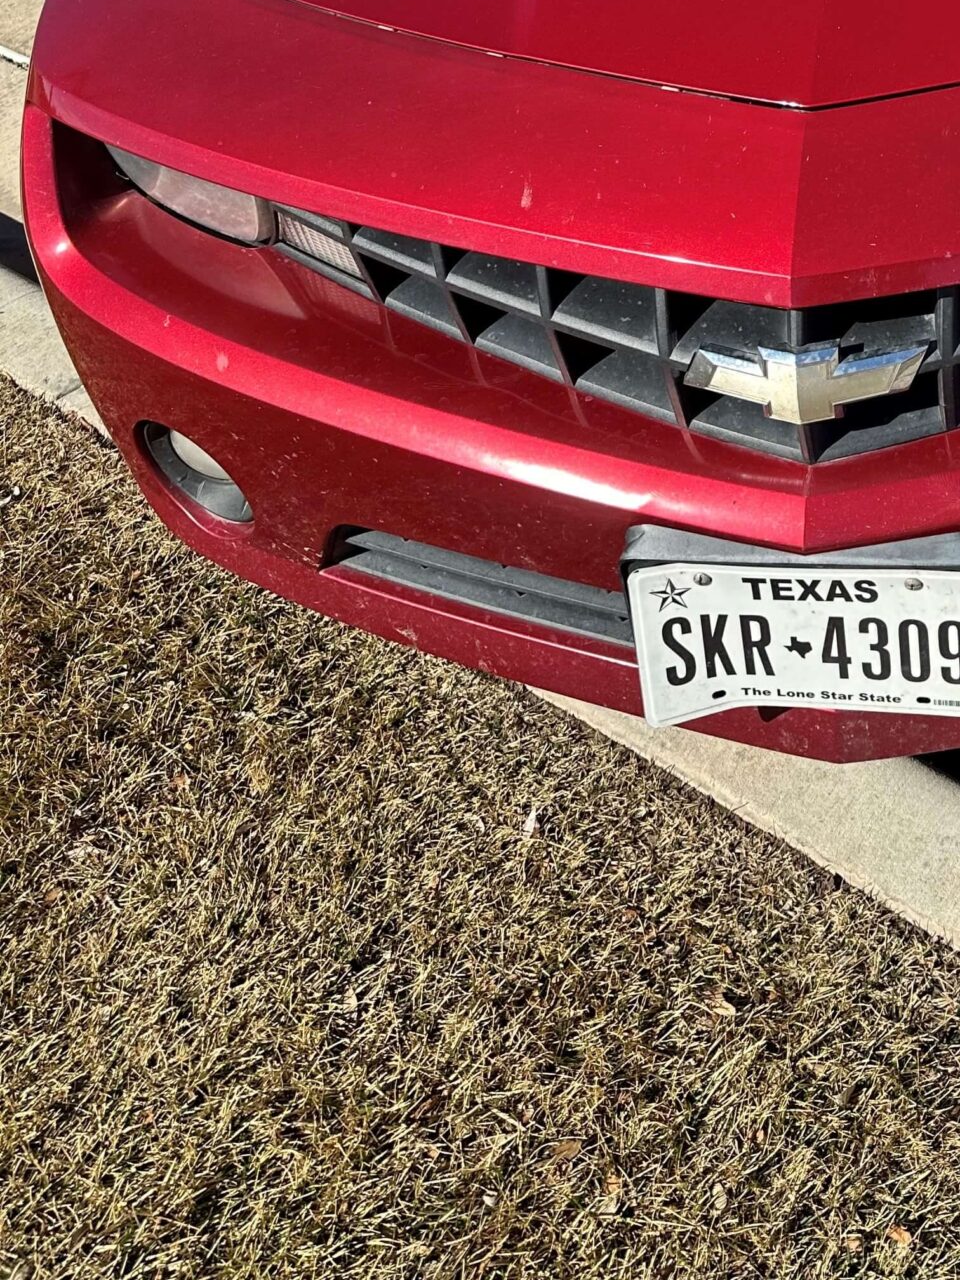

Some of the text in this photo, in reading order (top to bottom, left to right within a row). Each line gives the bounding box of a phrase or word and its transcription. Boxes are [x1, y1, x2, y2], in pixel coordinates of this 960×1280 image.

[741, 577, 879, 604] TEXAS
[661, 613, 776, 687] SKR
[741, 687, 902, 704] The Lone Star State
